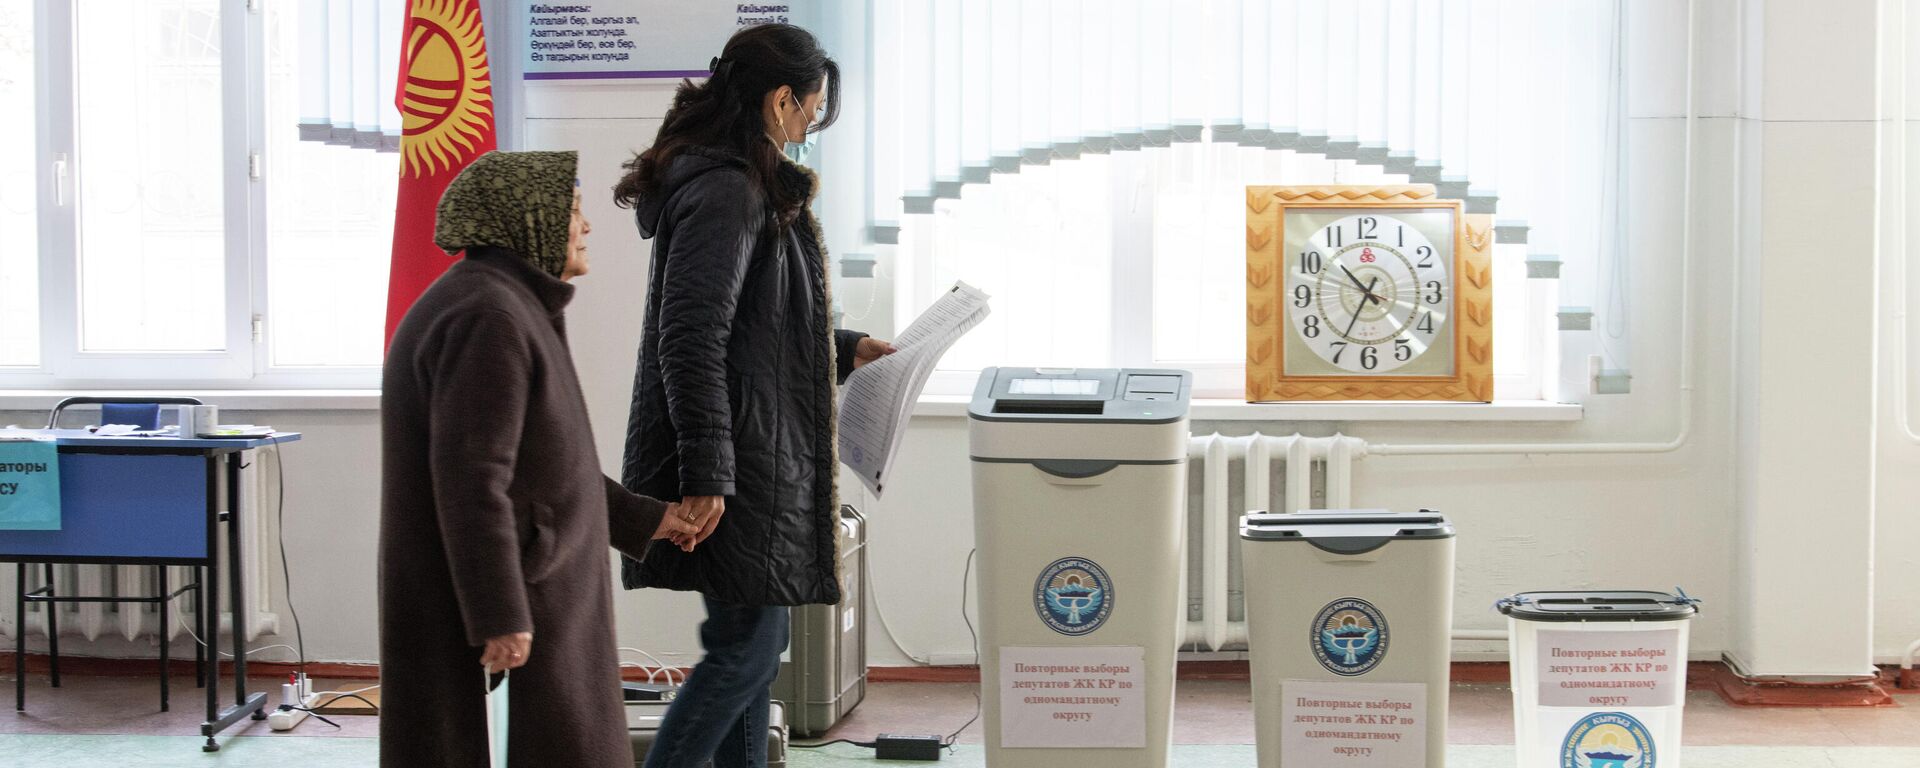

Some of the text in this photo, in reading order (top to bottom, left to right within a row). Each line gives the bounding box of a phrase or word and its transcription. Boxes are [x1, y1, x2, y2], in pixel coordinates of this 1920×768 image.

[530, 5, 591, 15] Кайырмасы:
[530, 15, 640, 26] Алгалай бер, кыргыз эл,
[530, 28, 584, 37] Азаттыктын
[531, 40, 574, 51] Өркүндөй
[577, 39, 596, 50] бер,
[531, 52, 544, 61] Өз
[592, 52, 629, 62] колунда
[1357, 216, 1378, 240] 12
[1327, 225, 1342, 247] 11
[1398, 225, 1404, 247] 1
[1300, 251, 1321, 274] 10
[1416, 246, 1433, 268] 2
[1294, 284, 1311, 308] 9
[1426, 281, 1442, 304] 3
[1303, 315, 1320, 338] 8
[1416, 311, 1433, 334] 4
[1330, 342, 1348, 364] 7
[1394, 339, 1412, 361] 5
[1360, 346, 1378, 370] 6
[1552, 648, 1666, 659] Повторные выборы
[1014, 663, 1130, 676] Повторные выборы
[1548, 665, 1607, 675] депутатов
[1610, 663, 1632, 672] ЖК
[1635, 663, 1653, 672] КР
[1012, 679, 1132, 691] депутатов ЖК КР по
[1560, 681, 1657, 690] одномандатному
[1024, 695, 1121, 706] одномандатному
[1296, 697, 1412, 711] Повторные выборы
[1589, 696, 1629, 706] округу
[1053, 711, 1093, 722] округу
[1294, 714, 1414, 725] депутатов ЖК КР по
[1305, 731, 1402, 742] одномандатному
[1333, 746, 1373, 757] округу
